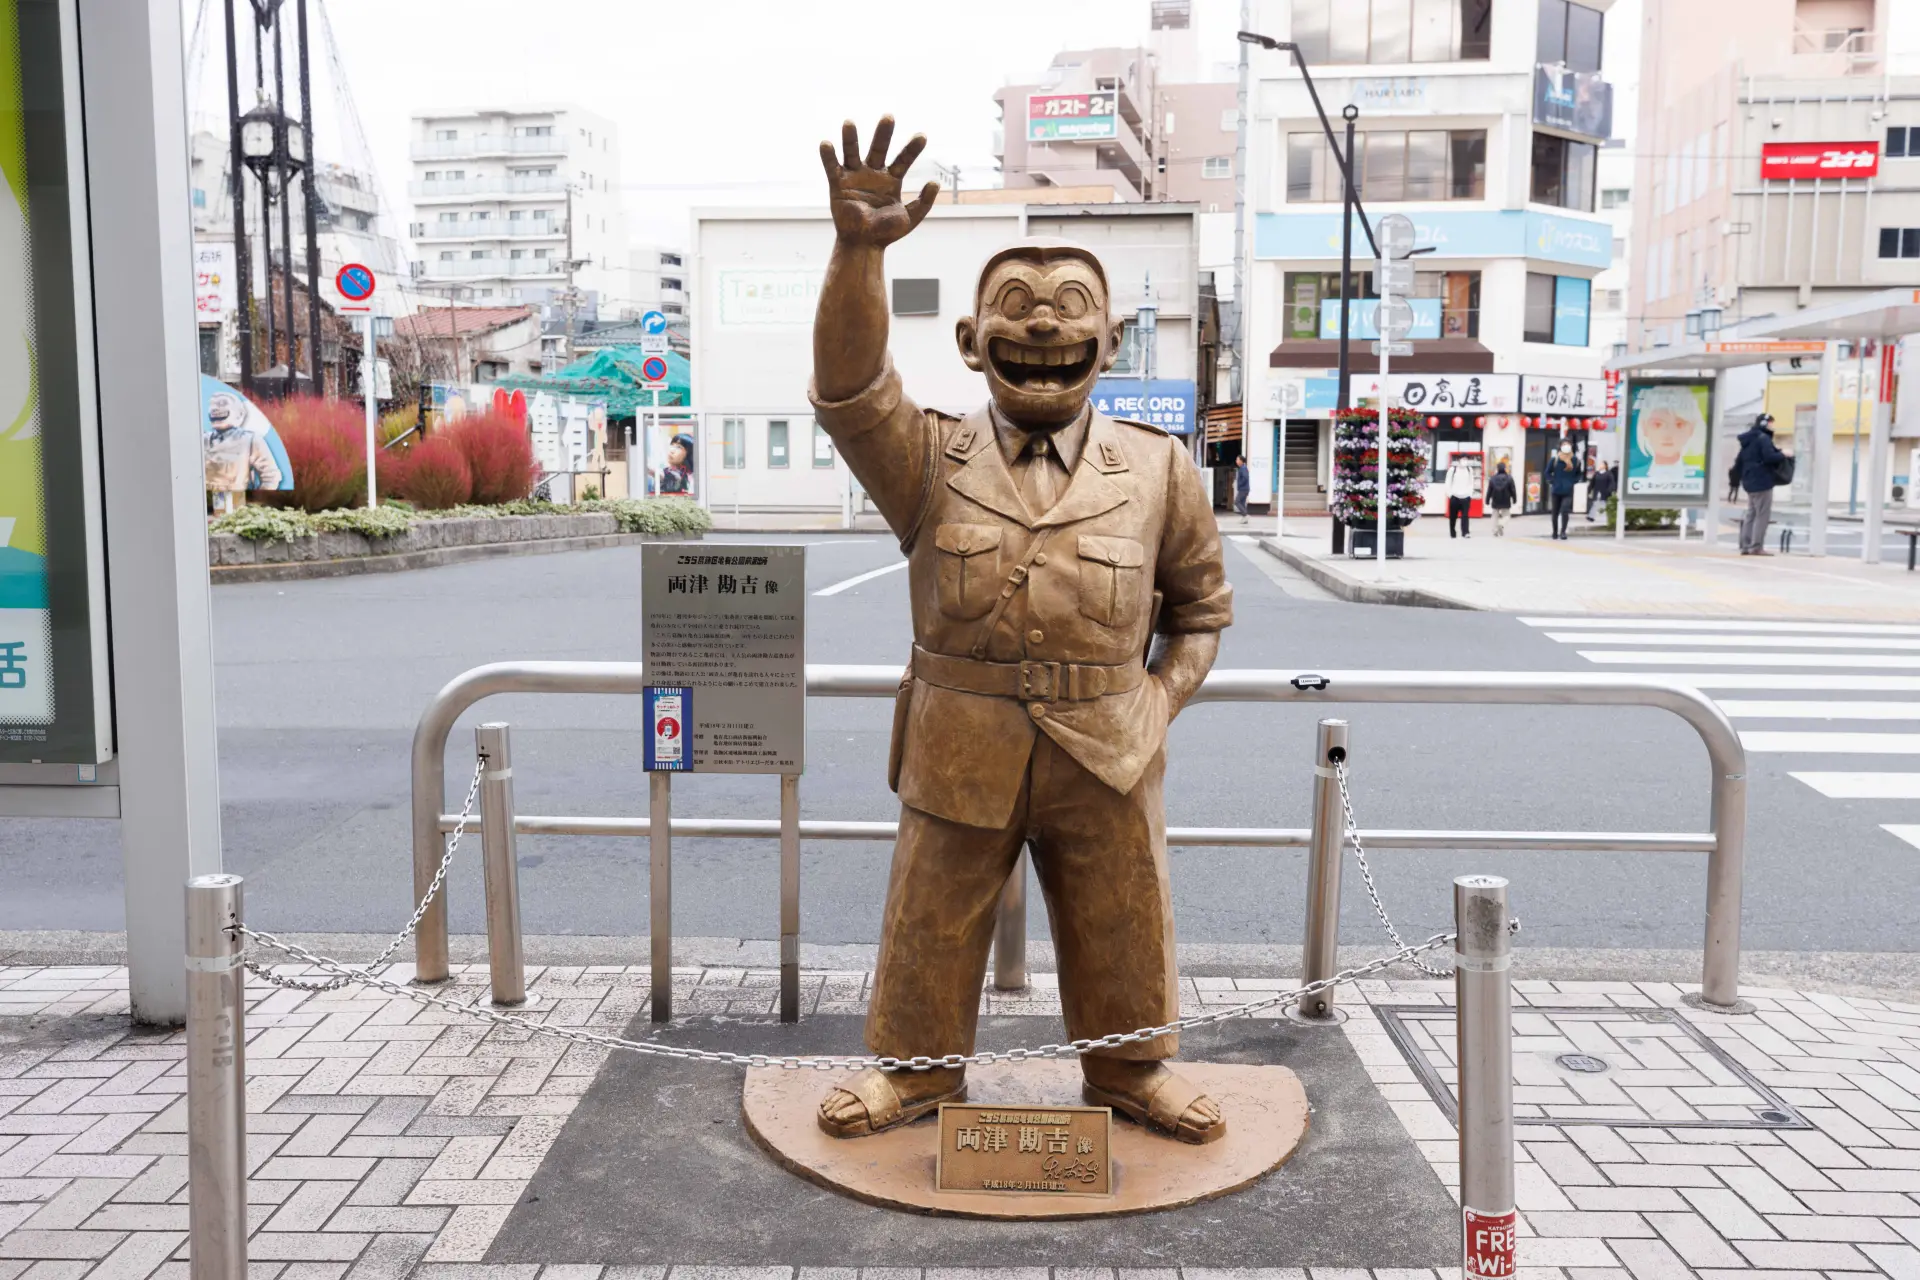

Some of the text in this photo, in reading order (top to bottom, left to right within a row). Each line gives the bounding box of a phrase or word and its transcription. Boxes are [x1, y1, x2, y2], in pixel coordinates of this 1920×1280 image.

[1045, 99, 1087, 116] ガスト
[1090, 96, 1114, 115] 2F
[1820, 151, 1875, 168] コナカ
[1404, 377, 1488, 408] 日高屋
[1546, 383, 1585, 409] 日高屋
[1097, 397, 1186, 412] & RECORD
[668, 574, 779, 594] 両津 勘吉 像
[957, 1125, 1094, 1154] 両津 勘吉 像
[1475, 1227, 1515, 1252] FRE
